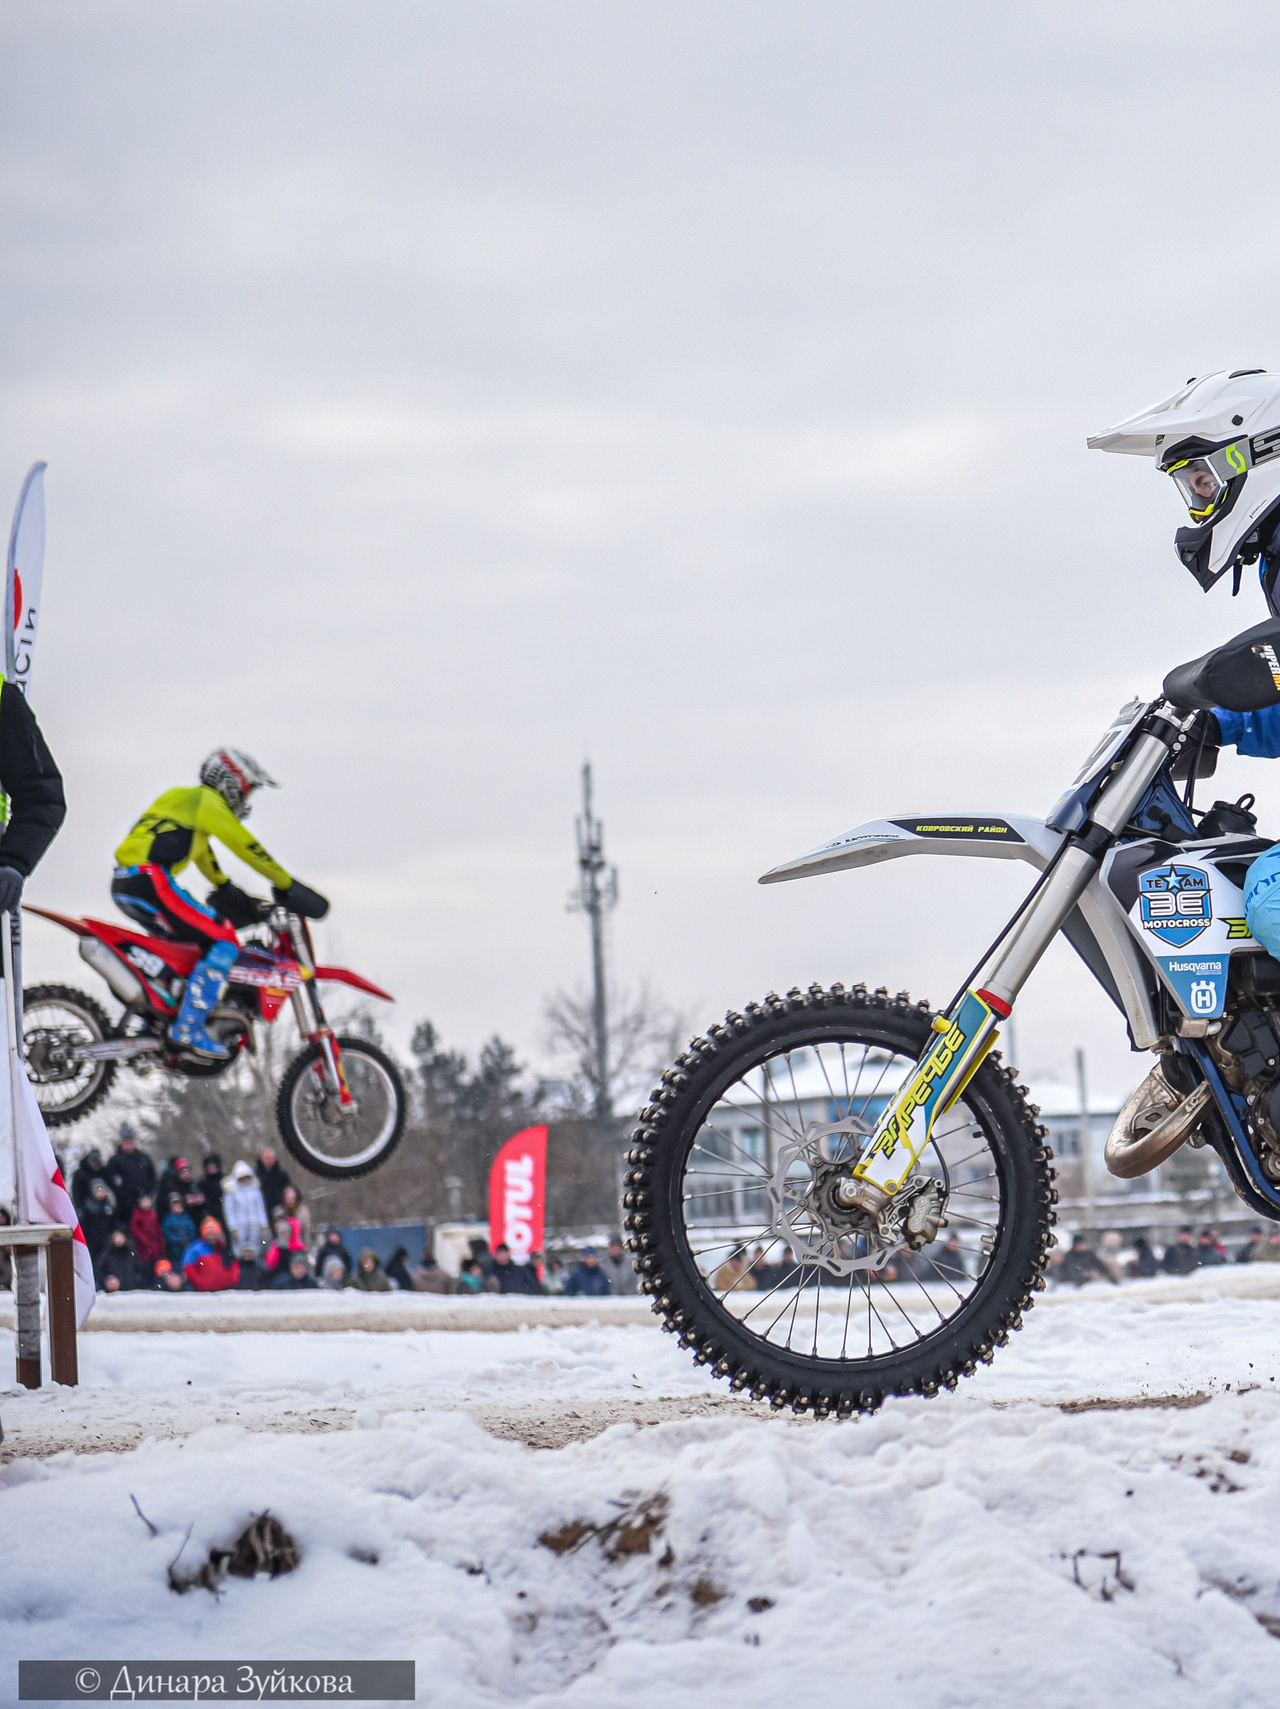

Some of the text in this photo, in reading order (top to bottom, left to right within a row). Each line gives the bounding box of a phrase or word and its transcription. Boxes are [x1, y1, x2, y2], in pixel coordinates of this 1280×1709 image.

[916, 824, 1008, 834] КОВРОВСКИЙ РАЙОН
[1144, 918, 1211, 930] MOTOCROSS
[1169, 961, 1222, 972] Husqvarna
